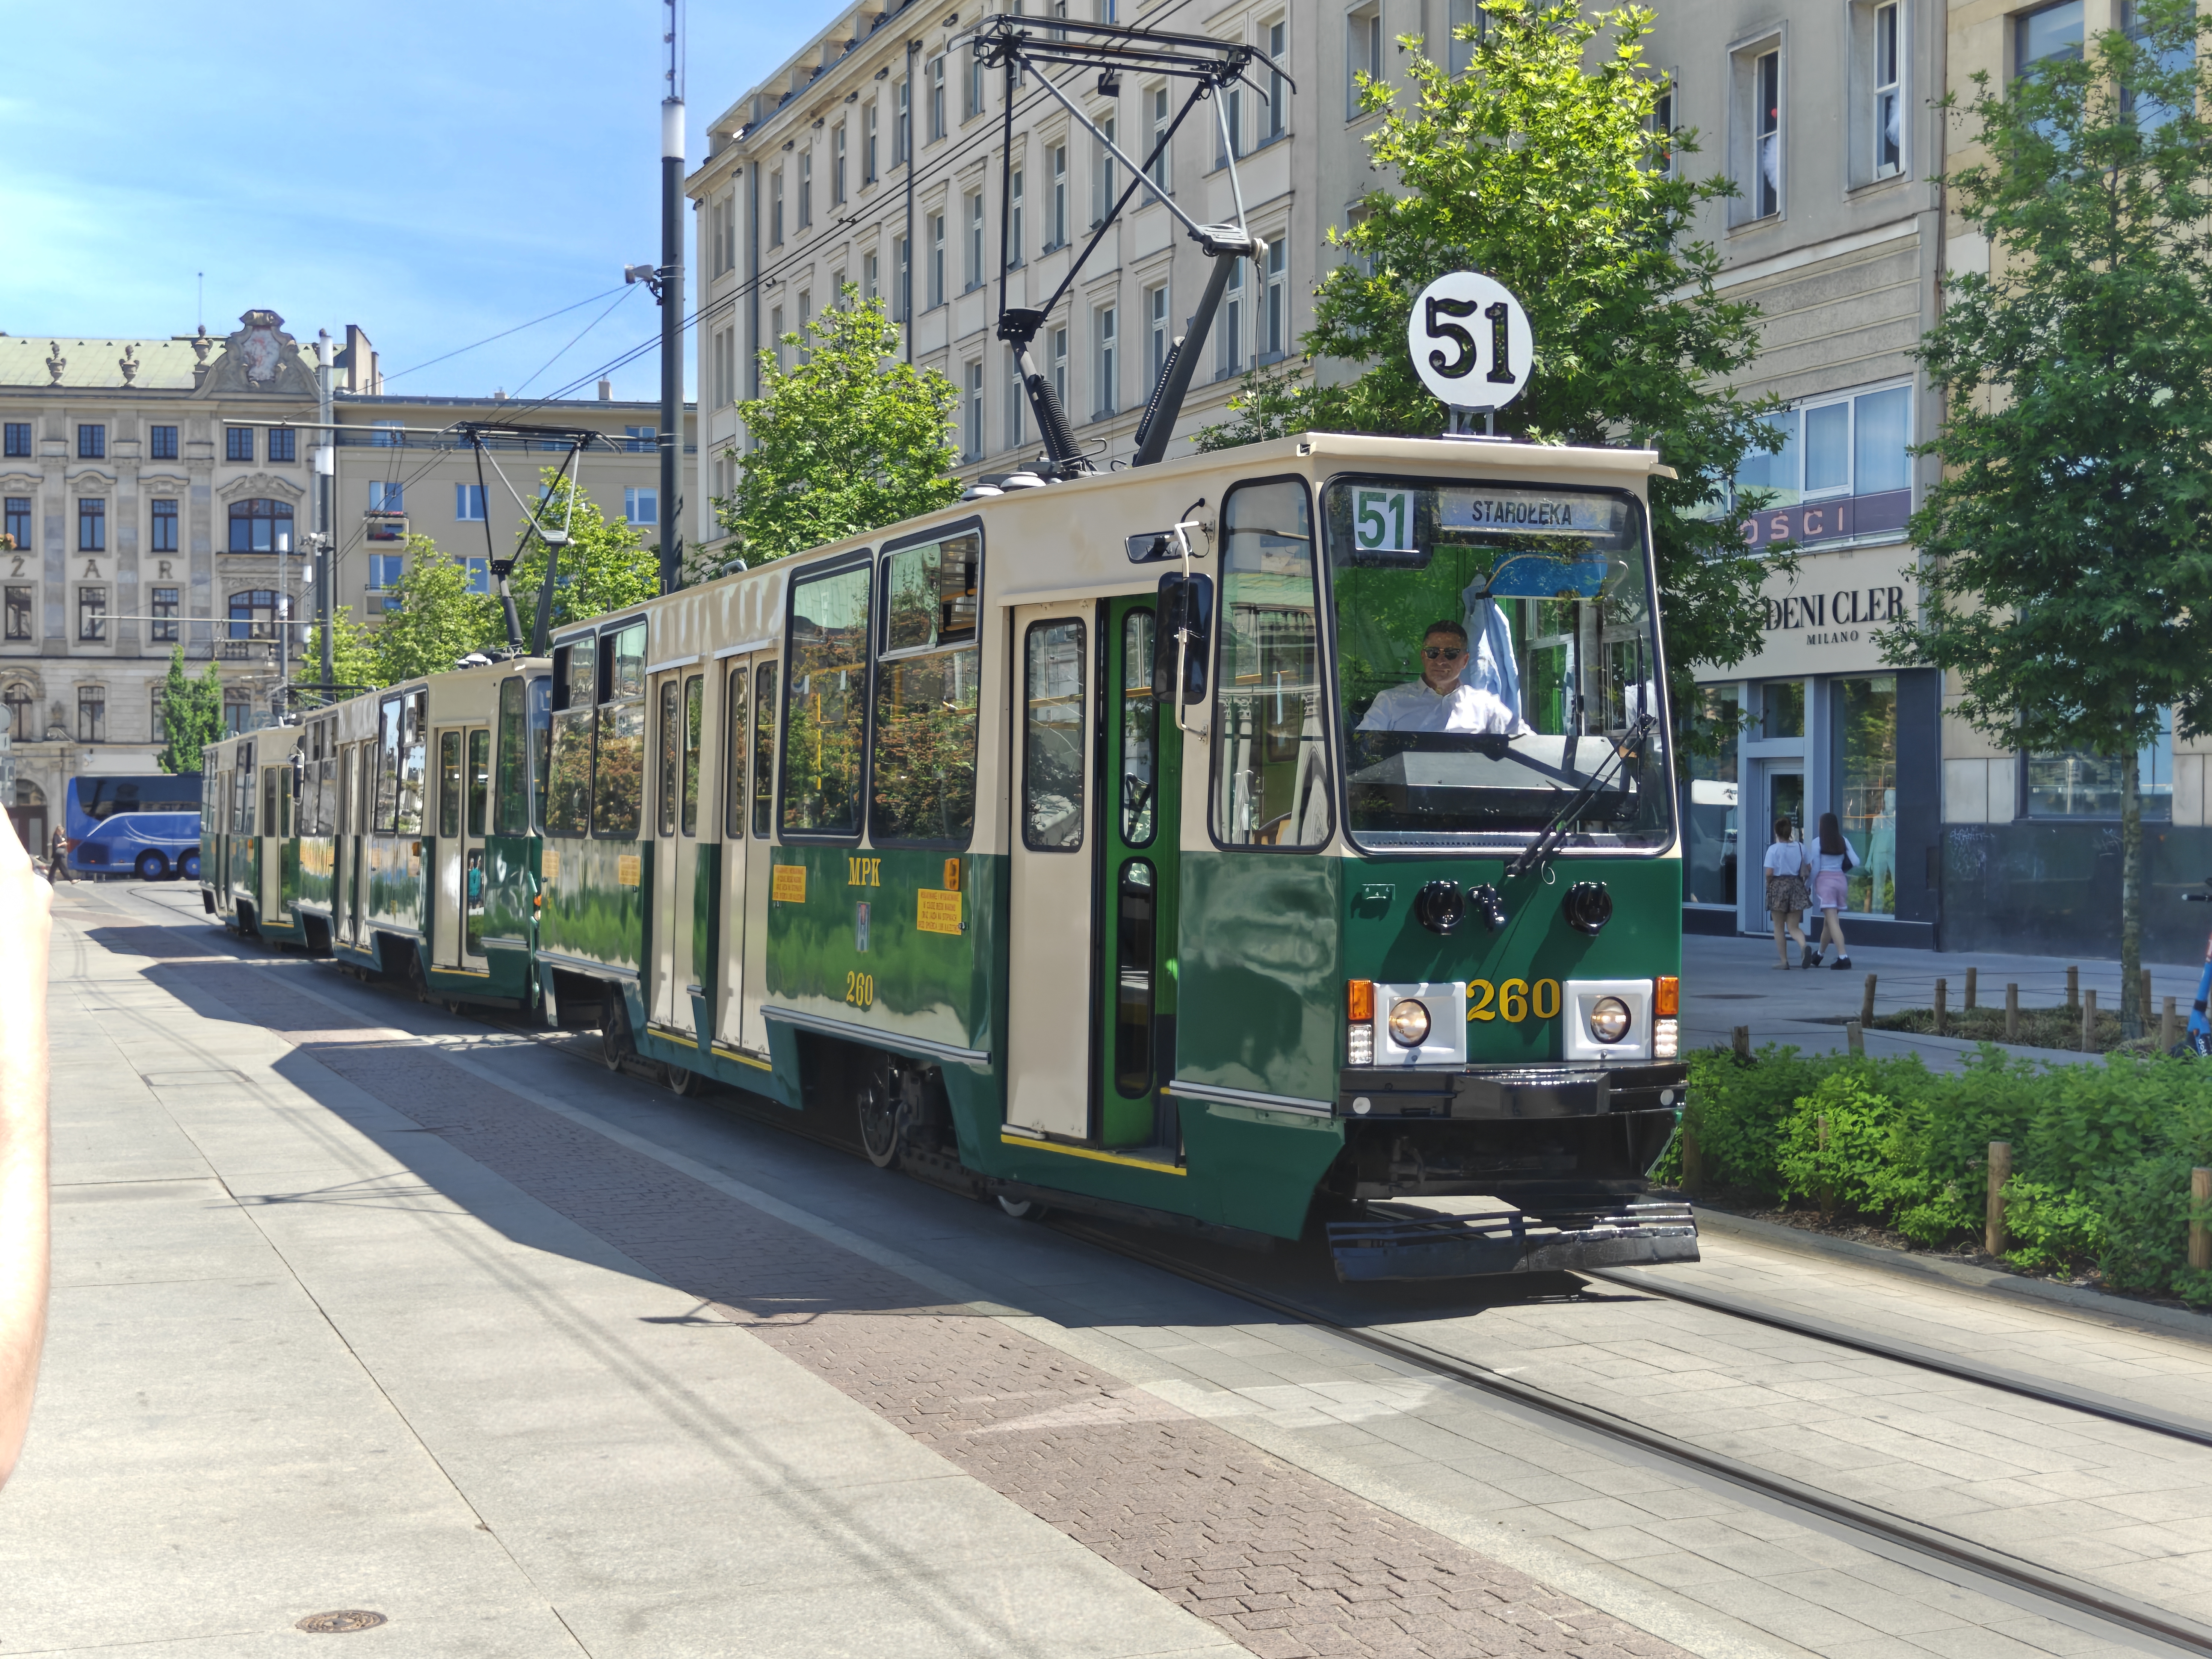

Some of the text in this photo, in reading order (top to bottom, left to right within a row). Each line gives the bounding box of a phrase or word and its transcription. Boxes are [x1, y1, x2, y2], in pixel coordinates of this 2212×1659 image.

[1425, 296, 1516, 384] 51
[1357, 491, 1405, 550] 51
[1472, 500, 1572, 525] STAROŁĘKA
[1766, 586, 1904, 631] DENI CLER
[1807, 630, 1859, 645] MILANO
[848, 857, 881, 887] MPK
[846, 971, 873, 1006] 260
[1466, 978, 1561, 1023] 260
